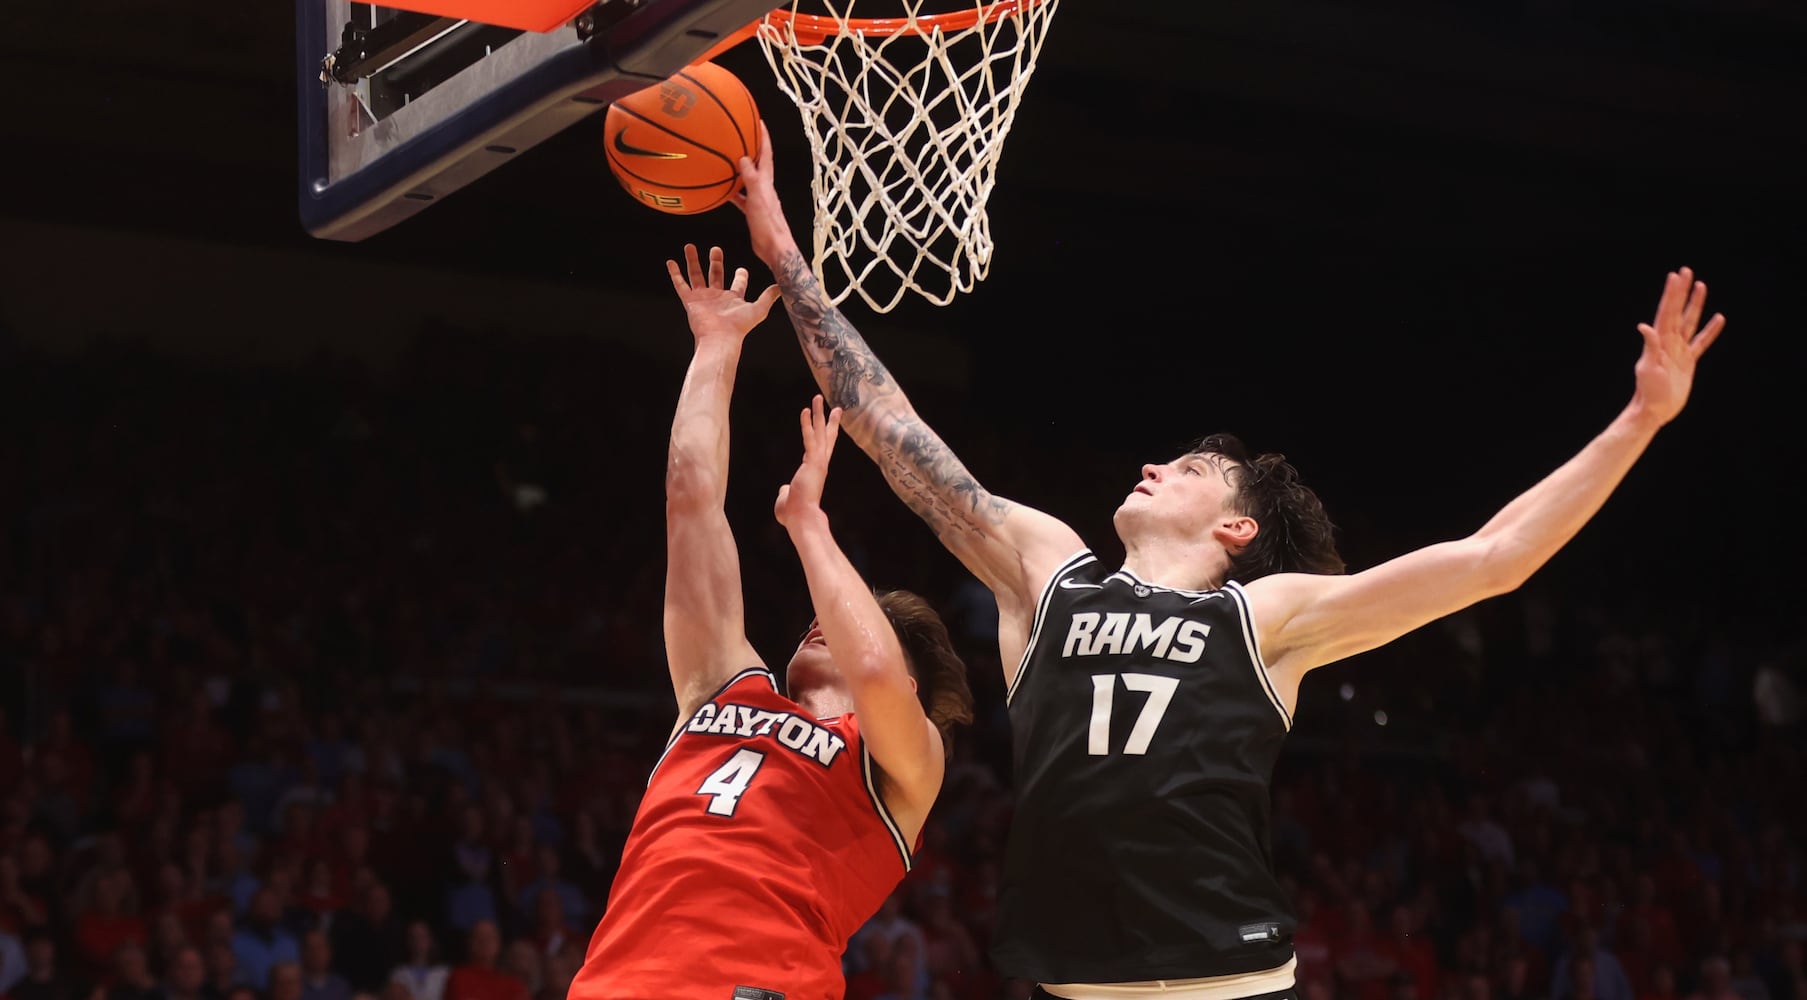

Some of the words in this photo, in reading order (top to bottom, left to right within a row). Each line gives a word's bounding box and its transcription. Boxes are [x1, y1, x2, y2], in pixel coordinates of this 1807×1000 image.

[1062, 612, 1211, 663] RAMS
[686, 702, 847, 768] DAYTON
[1088, 673, 1181, 755] 17
[696, 748, 766, 818] 4
